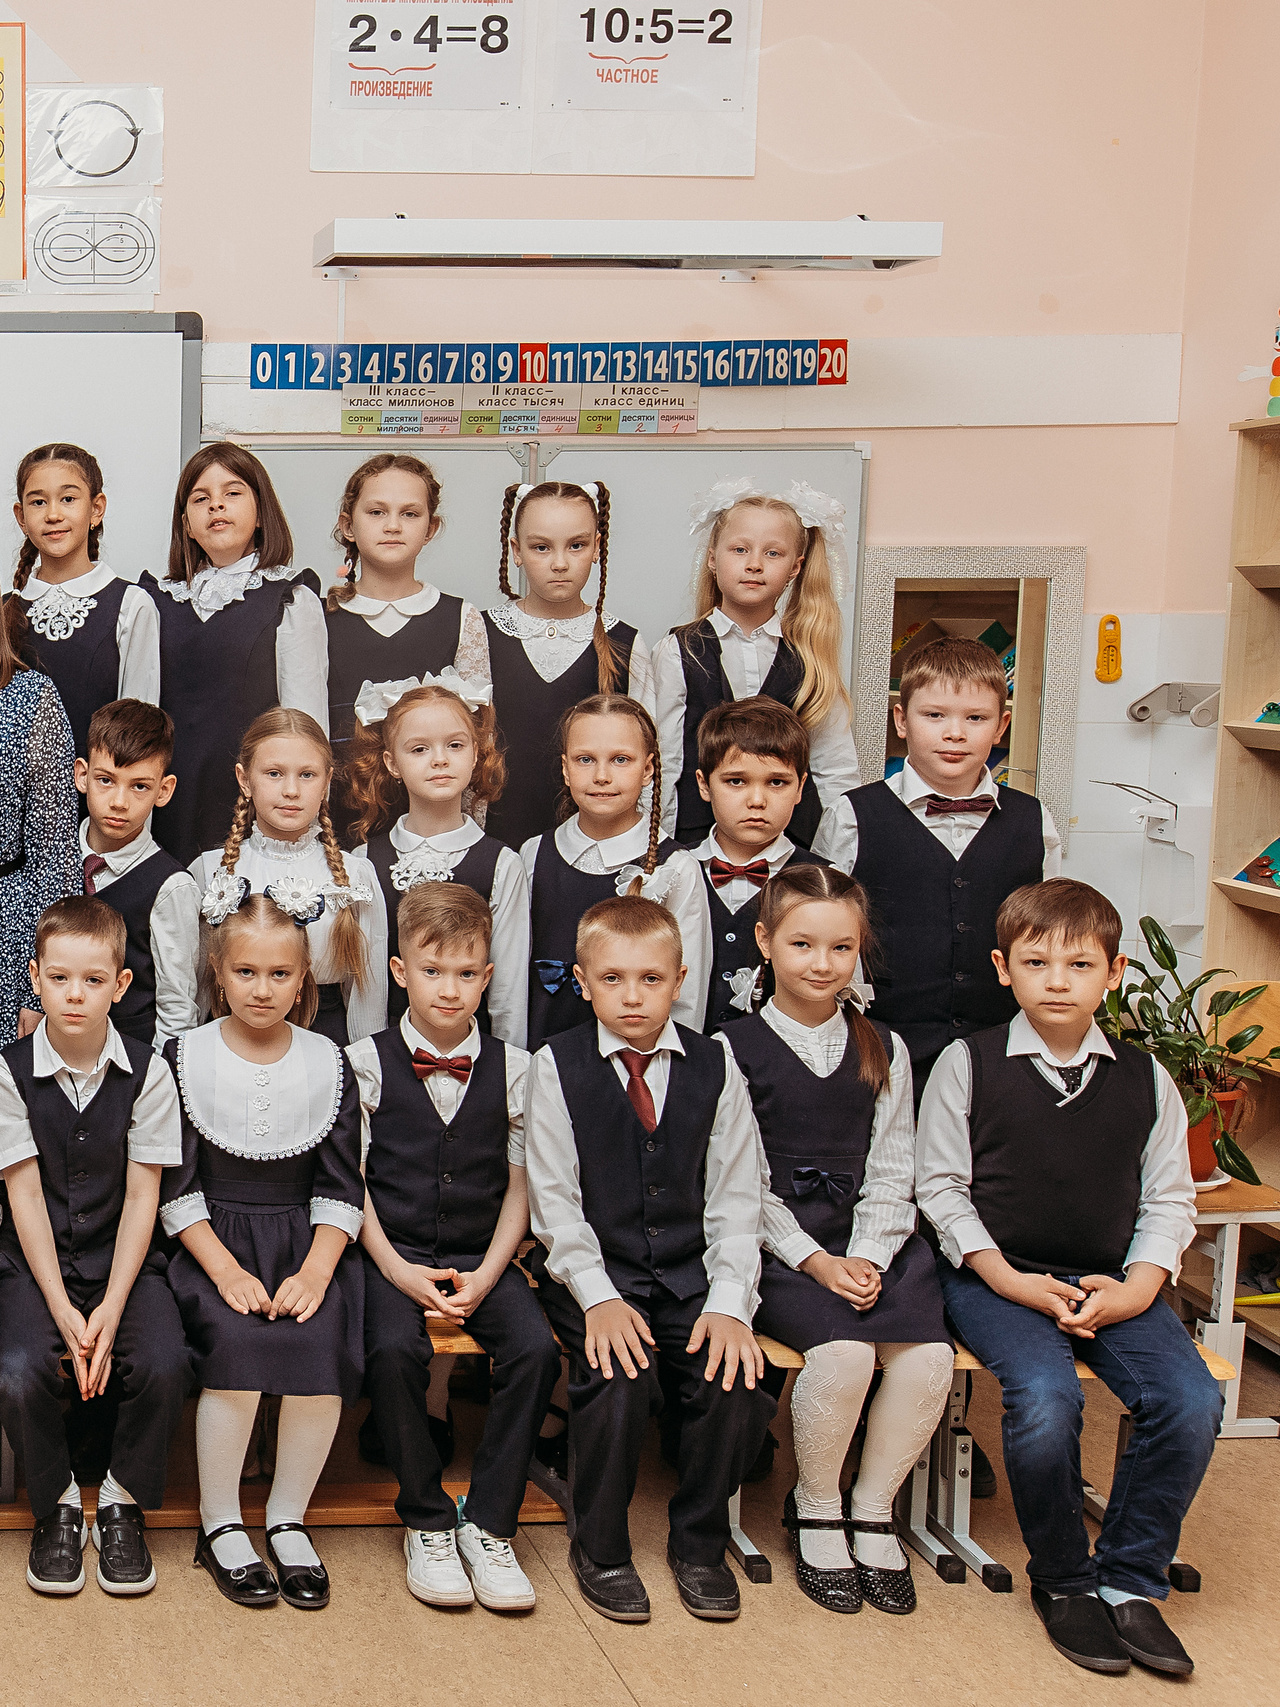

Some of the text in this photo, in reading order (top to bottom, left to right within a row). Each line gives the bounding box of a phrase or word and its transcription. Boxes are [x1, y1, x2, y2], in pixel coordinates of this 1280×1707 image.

[580, 8, 733, 44] 10:5=2
[597, 68, 658, 83] ЧАСТНОЕ
[350, 80, 433, 99] ПРОИЗВЕДЕНИЕ
[256, 347, 844, 383] 0 1 2 3 4 5 6 7 8 9 10 11 12 13 14 15 16 17 18 19 20
[349, 398, 454, 407] класс миллионов
[479, 398, 564, 406] класс тысяч
[594, 397, 685, 407] класс единиц
[503, 415, 535, 423] десятки
[541, 415, 577, 423] единицы
[622, 415, 654, 423] десятки
[660, 414, 695, 423] единицы
